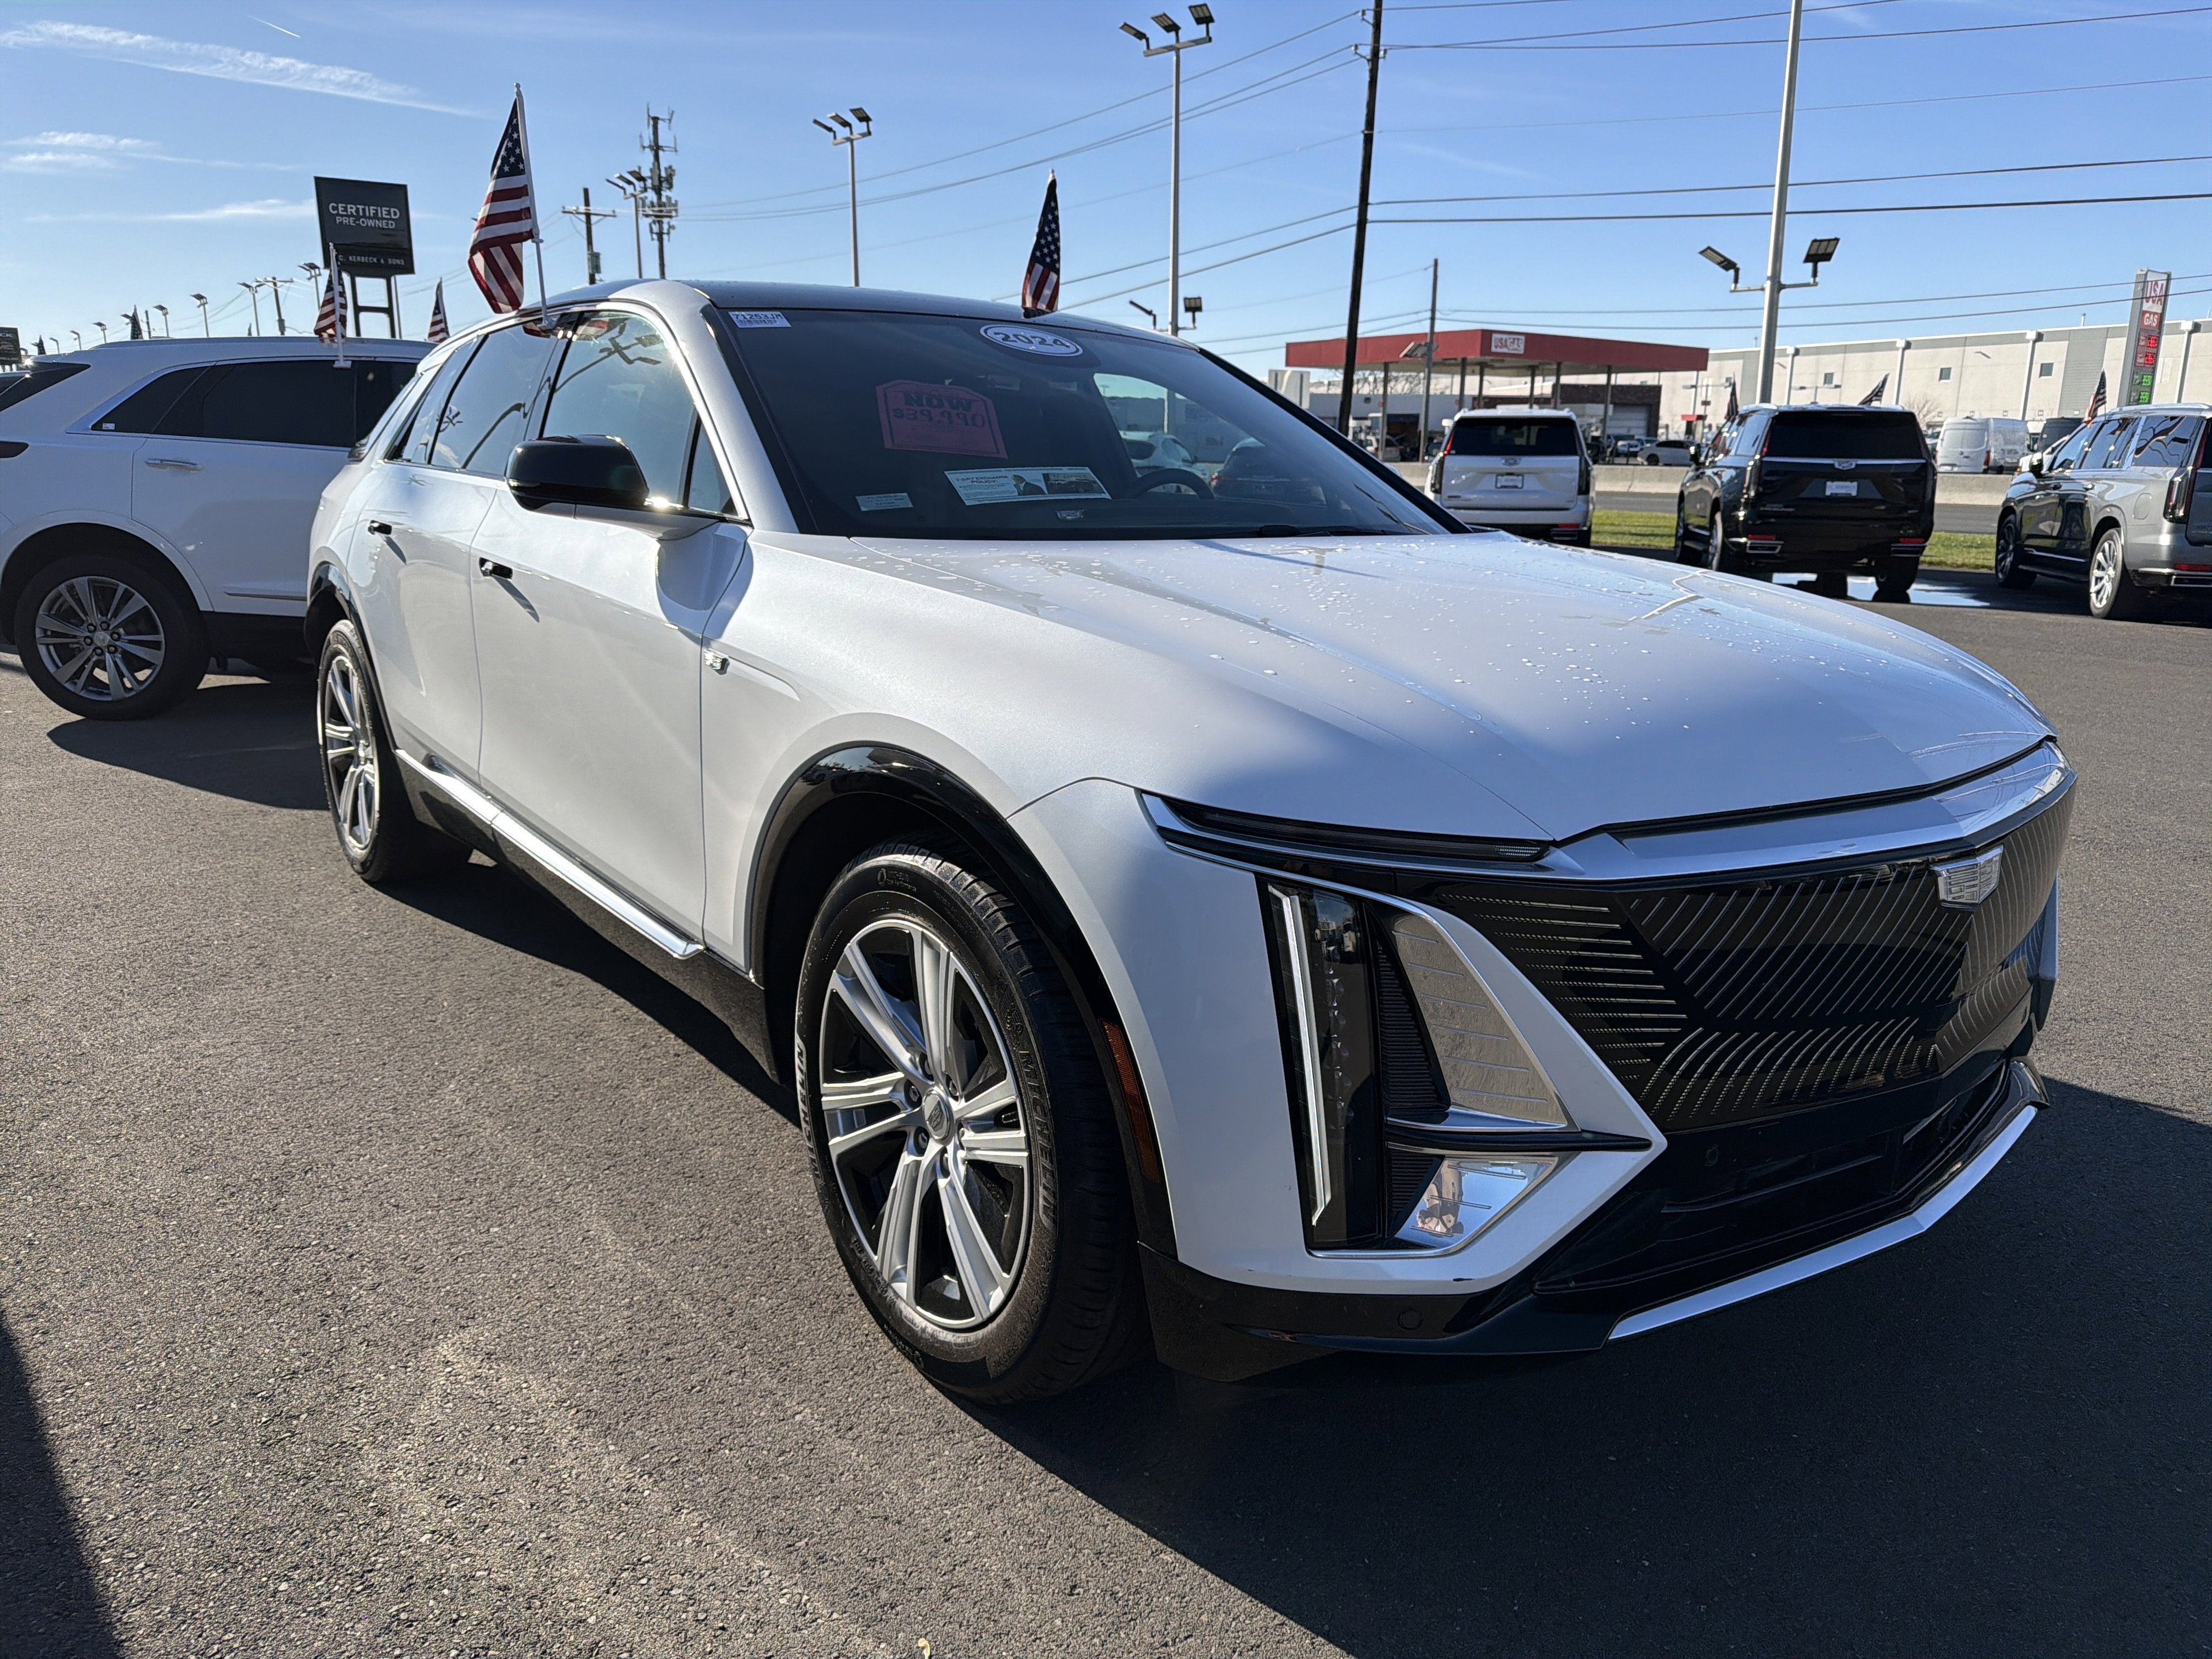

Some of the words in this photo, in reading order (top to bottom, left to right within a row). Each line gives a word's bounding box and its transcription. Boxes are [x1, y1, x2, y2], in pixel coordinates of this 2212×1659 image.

[329, 202, 400, 219] CERTIFIED
[336, 217, 396, 229] PRE-OWNED
[2145, 280, 2165, 306] USA
[2143, 312, 2159, 327] GAS
[993, 331, 1070, 349] 2024
[904, 392, 973, 411] NOW
[797, 1040, 821, 1180] MICHELIN
[1018, 1050, 1058, 1226] MICHELIN
